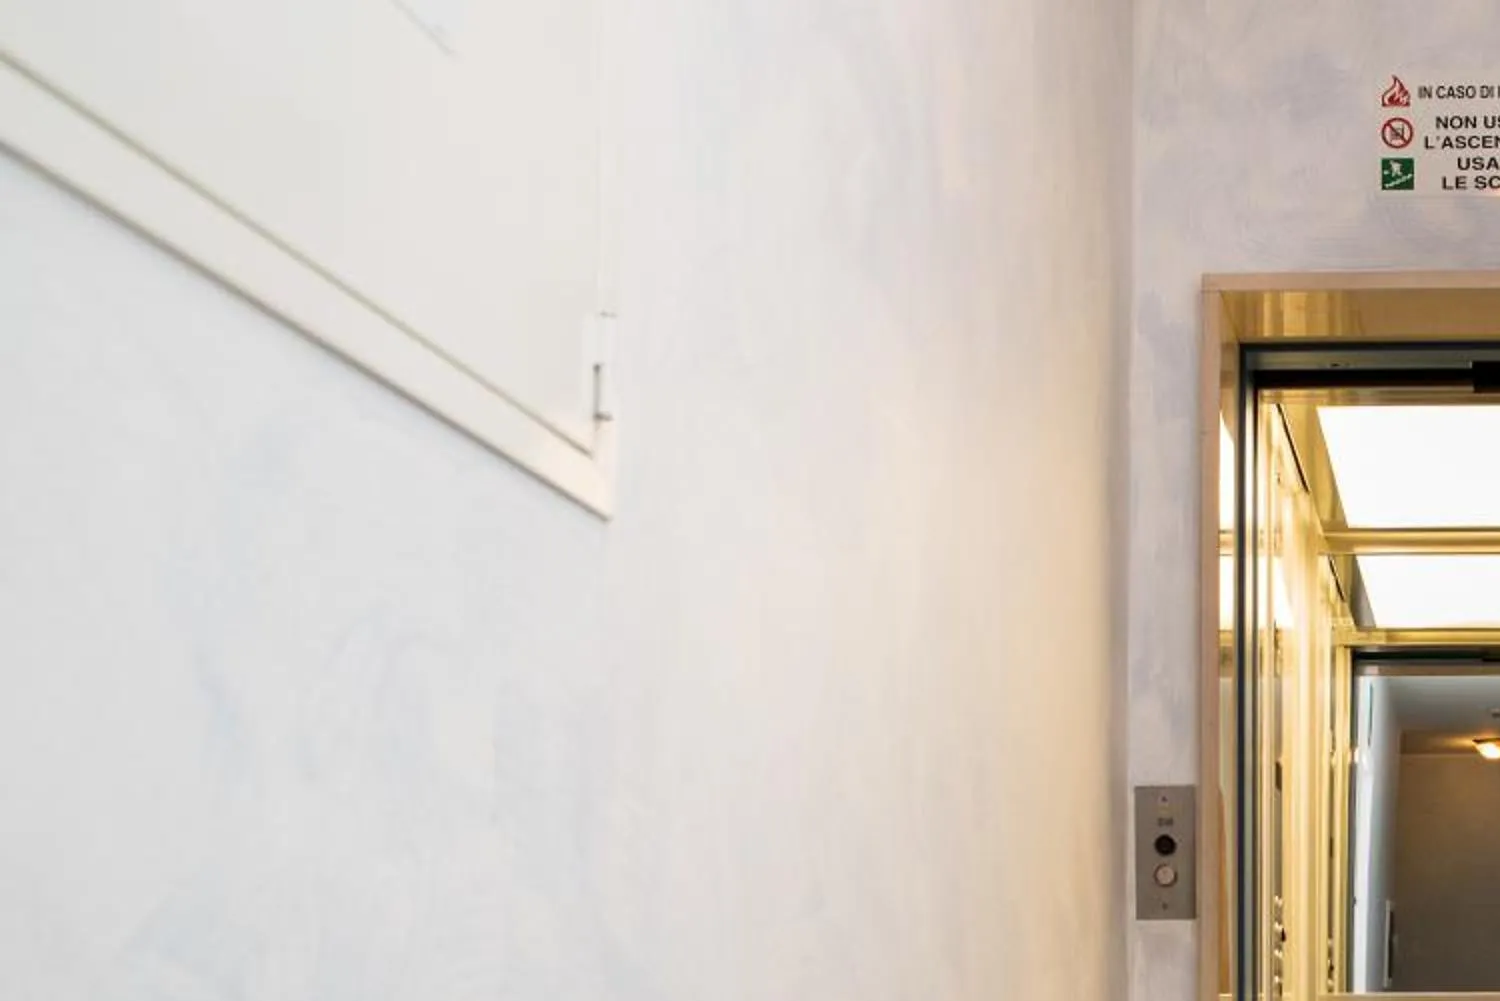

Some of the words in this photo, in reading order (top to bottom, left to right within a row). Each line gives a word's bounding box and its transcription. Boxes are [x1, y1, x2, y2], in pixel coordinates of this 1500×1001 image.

[1418, 86, 1432, 99] IN
[1436, 86, 1476, 99] CASO
[1480, 85, 1495, 98] DI
[1435, 116, 1477, 129] NON
[1442, 176, 1467, 190] LE
